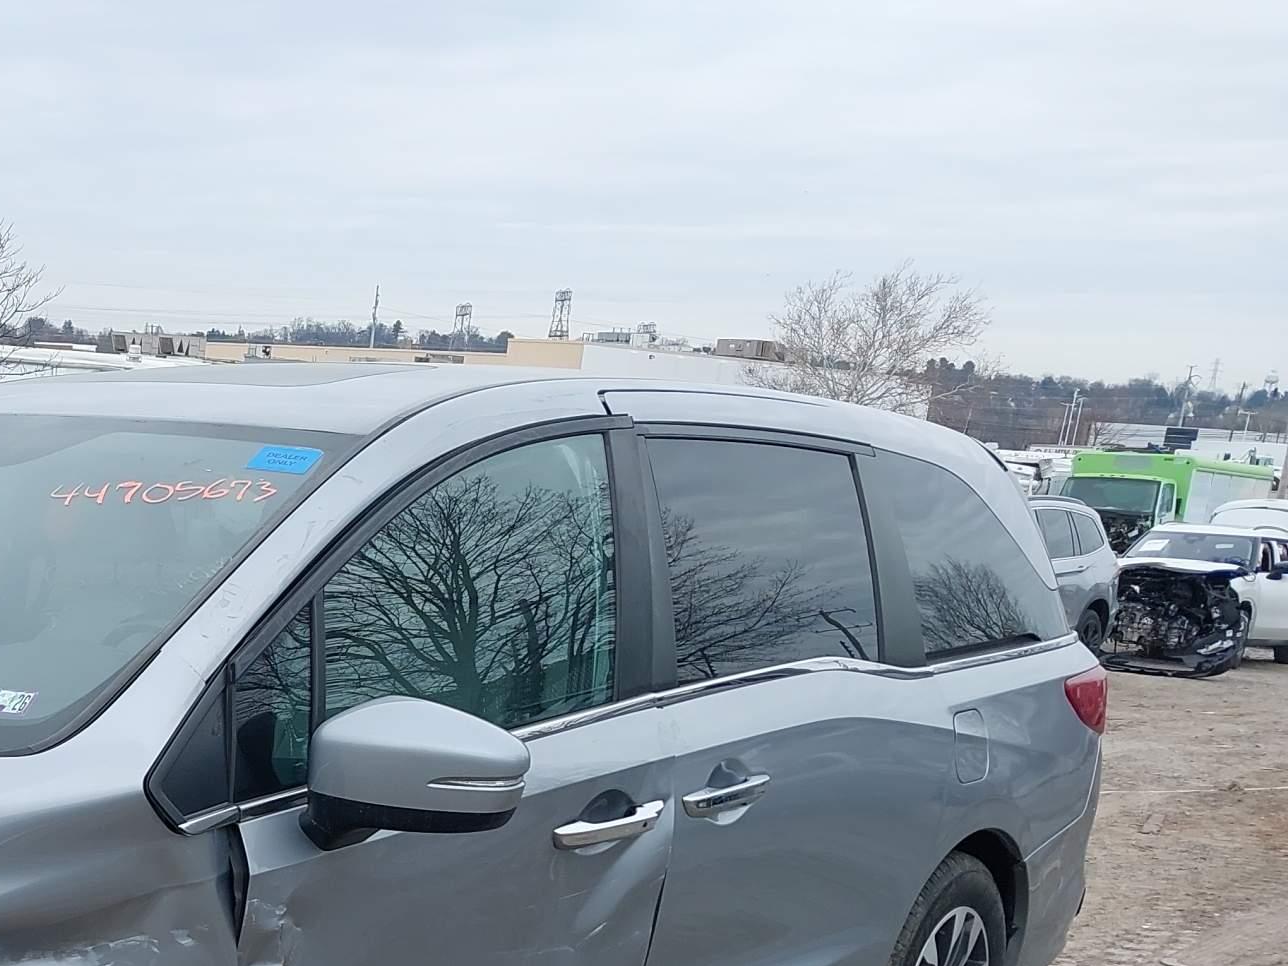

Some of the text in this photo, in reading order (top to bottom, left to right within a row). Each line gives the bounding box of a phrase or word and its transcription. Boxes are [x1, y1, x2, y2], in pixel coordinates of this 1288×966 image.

[266, 452, 309, 461] DEALER
[267, 459, 297, 467] ONLY
[50, 478, 278, 507] 44705673
[12, 694, 32, 712] 26
